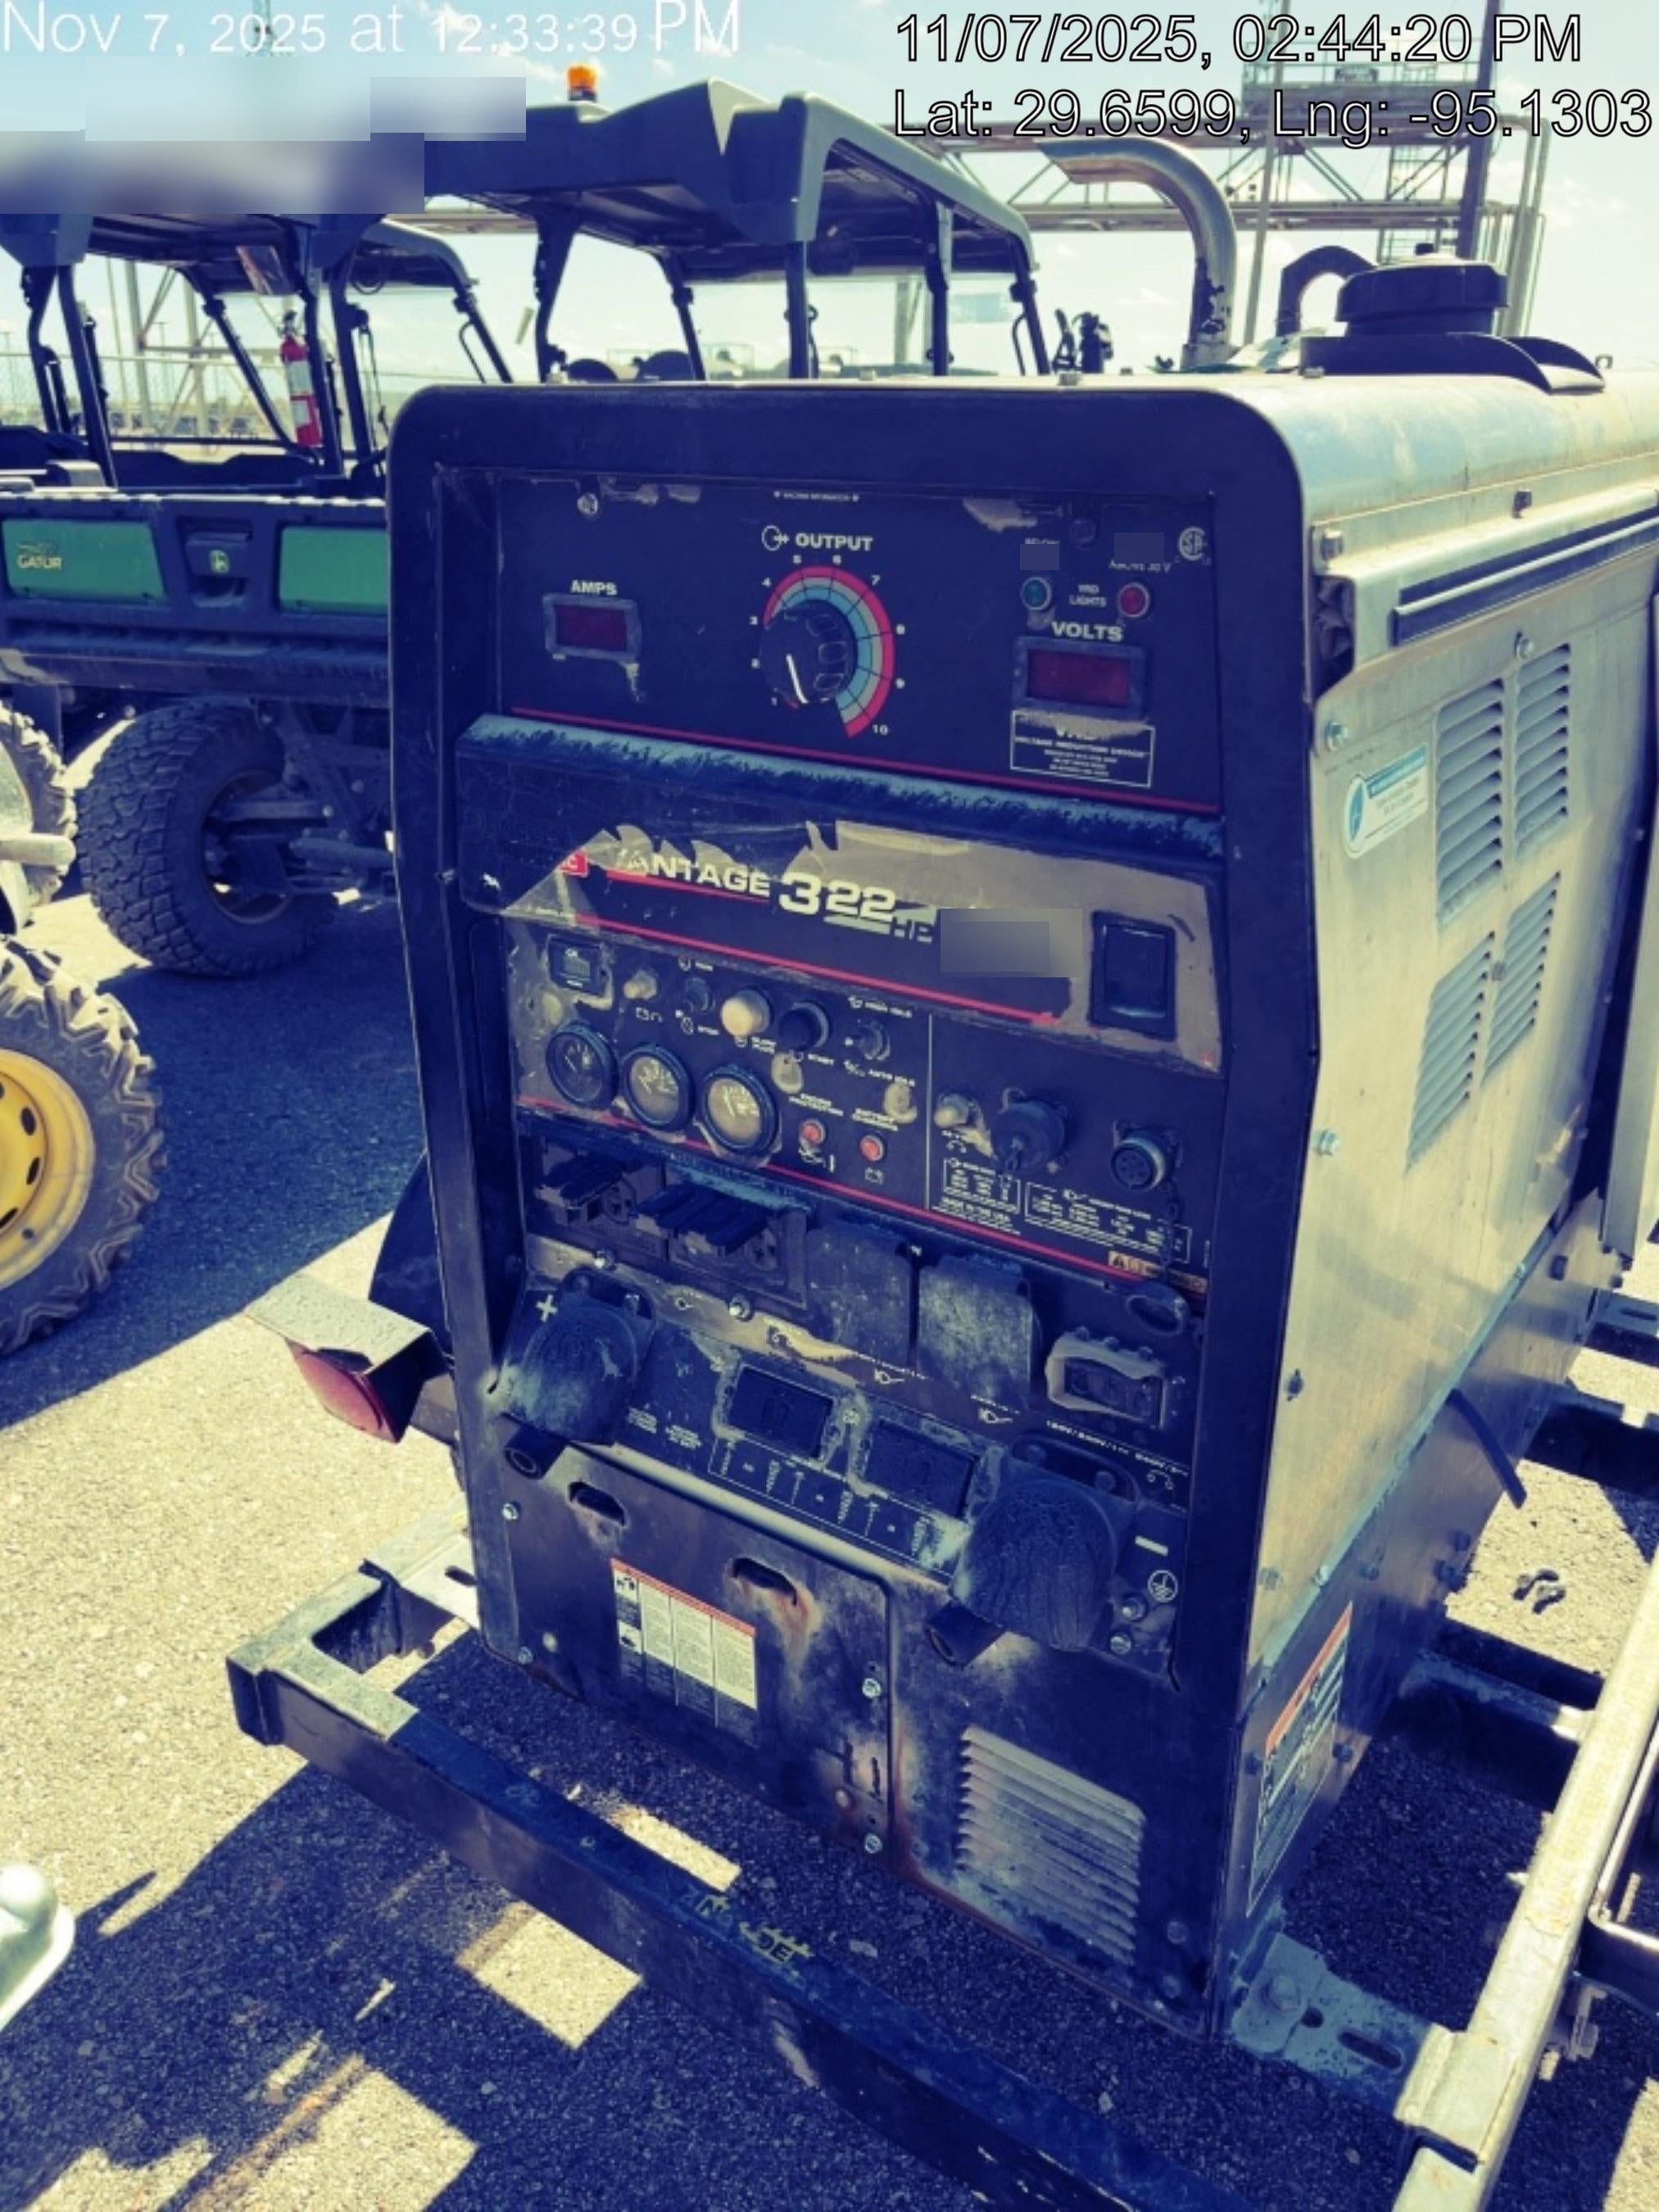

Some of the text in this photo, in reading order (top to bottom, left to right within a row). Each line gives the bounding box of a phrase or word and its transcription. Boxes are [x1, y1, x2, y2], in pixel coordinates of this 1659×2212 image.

[796, 533, 873, 551] OUTPUT
[17, 555, 62, 570] GATOR
[570, 579, 618, 596] AMPS
[761, 577, 772, 587] 4
[871, 574, 881, 586] 7
[1051, 620, 1124, 642] VOLTS
[872, 724, 889, 736] 10
[778, 871, 896, 923] 322
